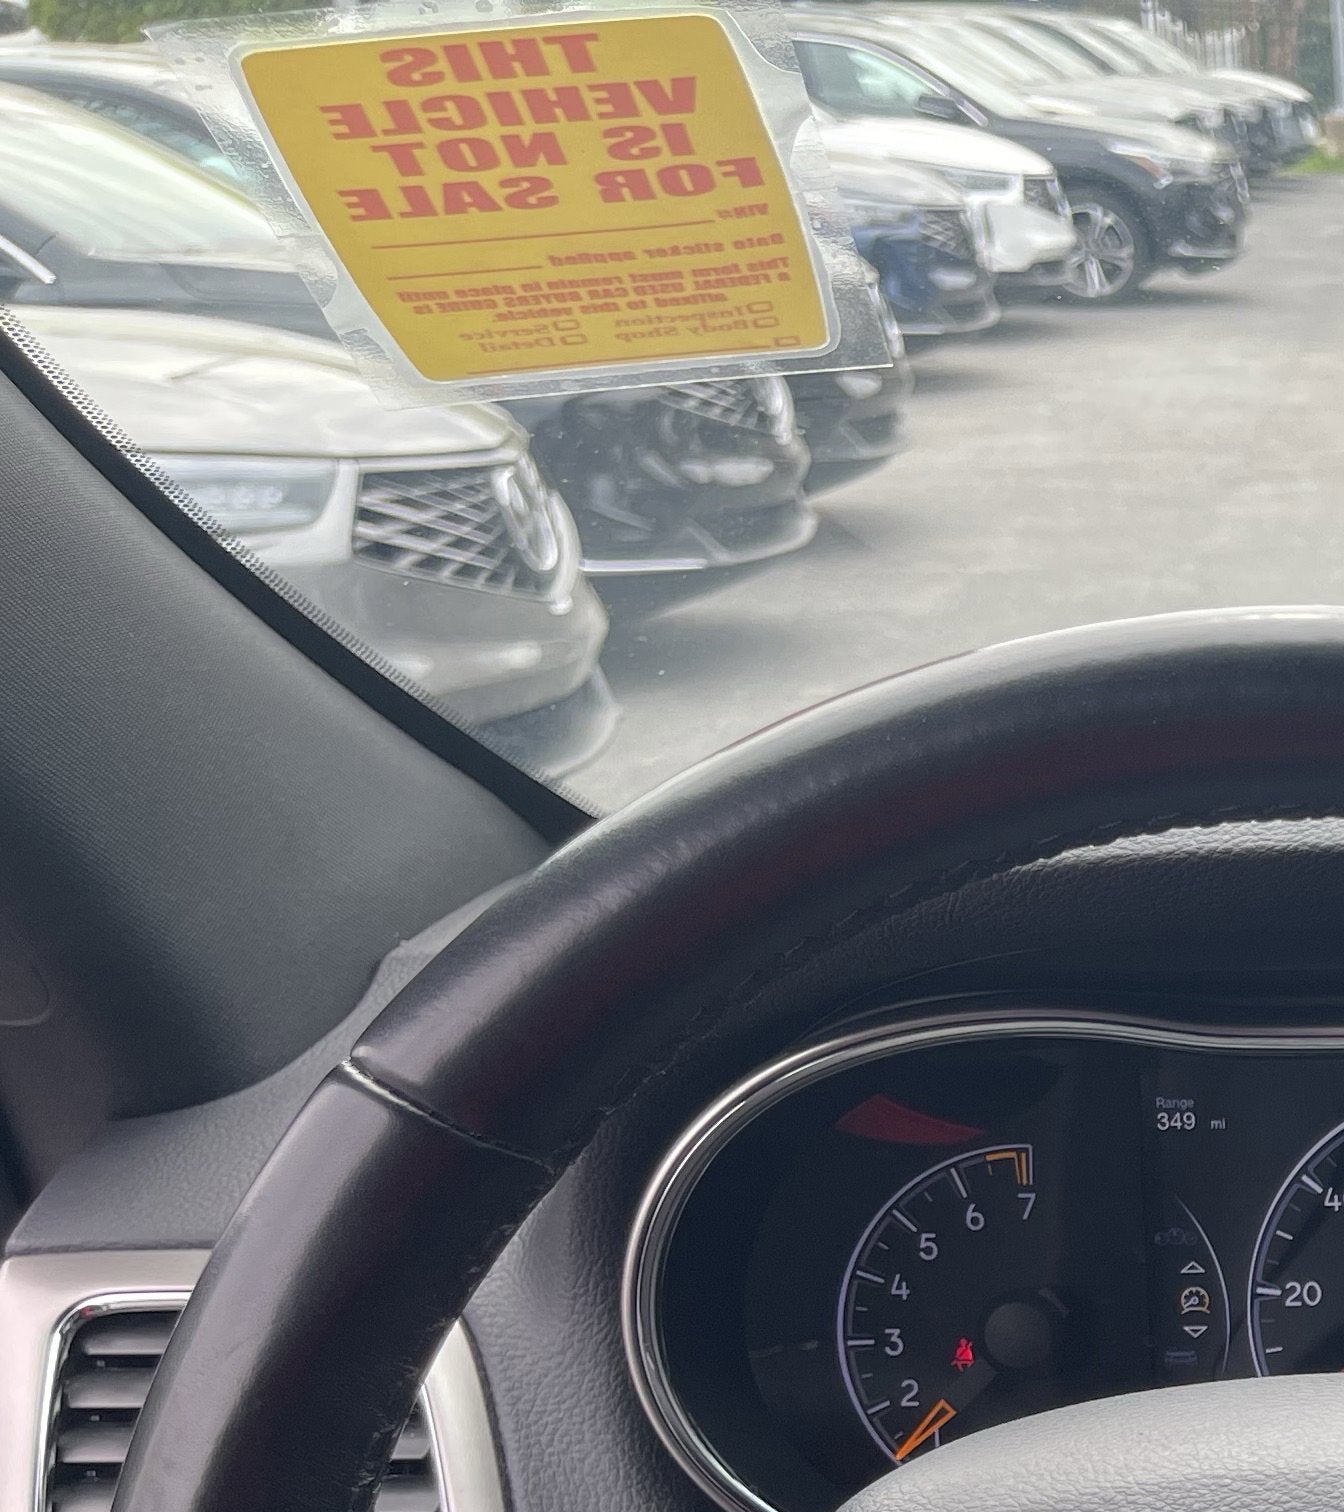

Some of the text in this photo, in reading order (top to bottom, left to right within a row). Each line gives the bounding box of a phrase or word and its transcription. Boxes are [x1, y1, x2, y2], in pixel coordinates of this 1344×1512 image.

[1155, 1096, 1194, 1109] Range
[1157, 1111, 1226, 1131] 349 mi
[965, 1203, 985, 1231] 6
[1017, 1192, 1036, 1220] 7
[919, 1232, 938, 1261] 5
[890, 1273, 911, 1301] 4
[1284, 1281, 1322, 1307] 20
[884, 1328, 904, 1356] 3
[900, 1379, 920, 1407] 2
